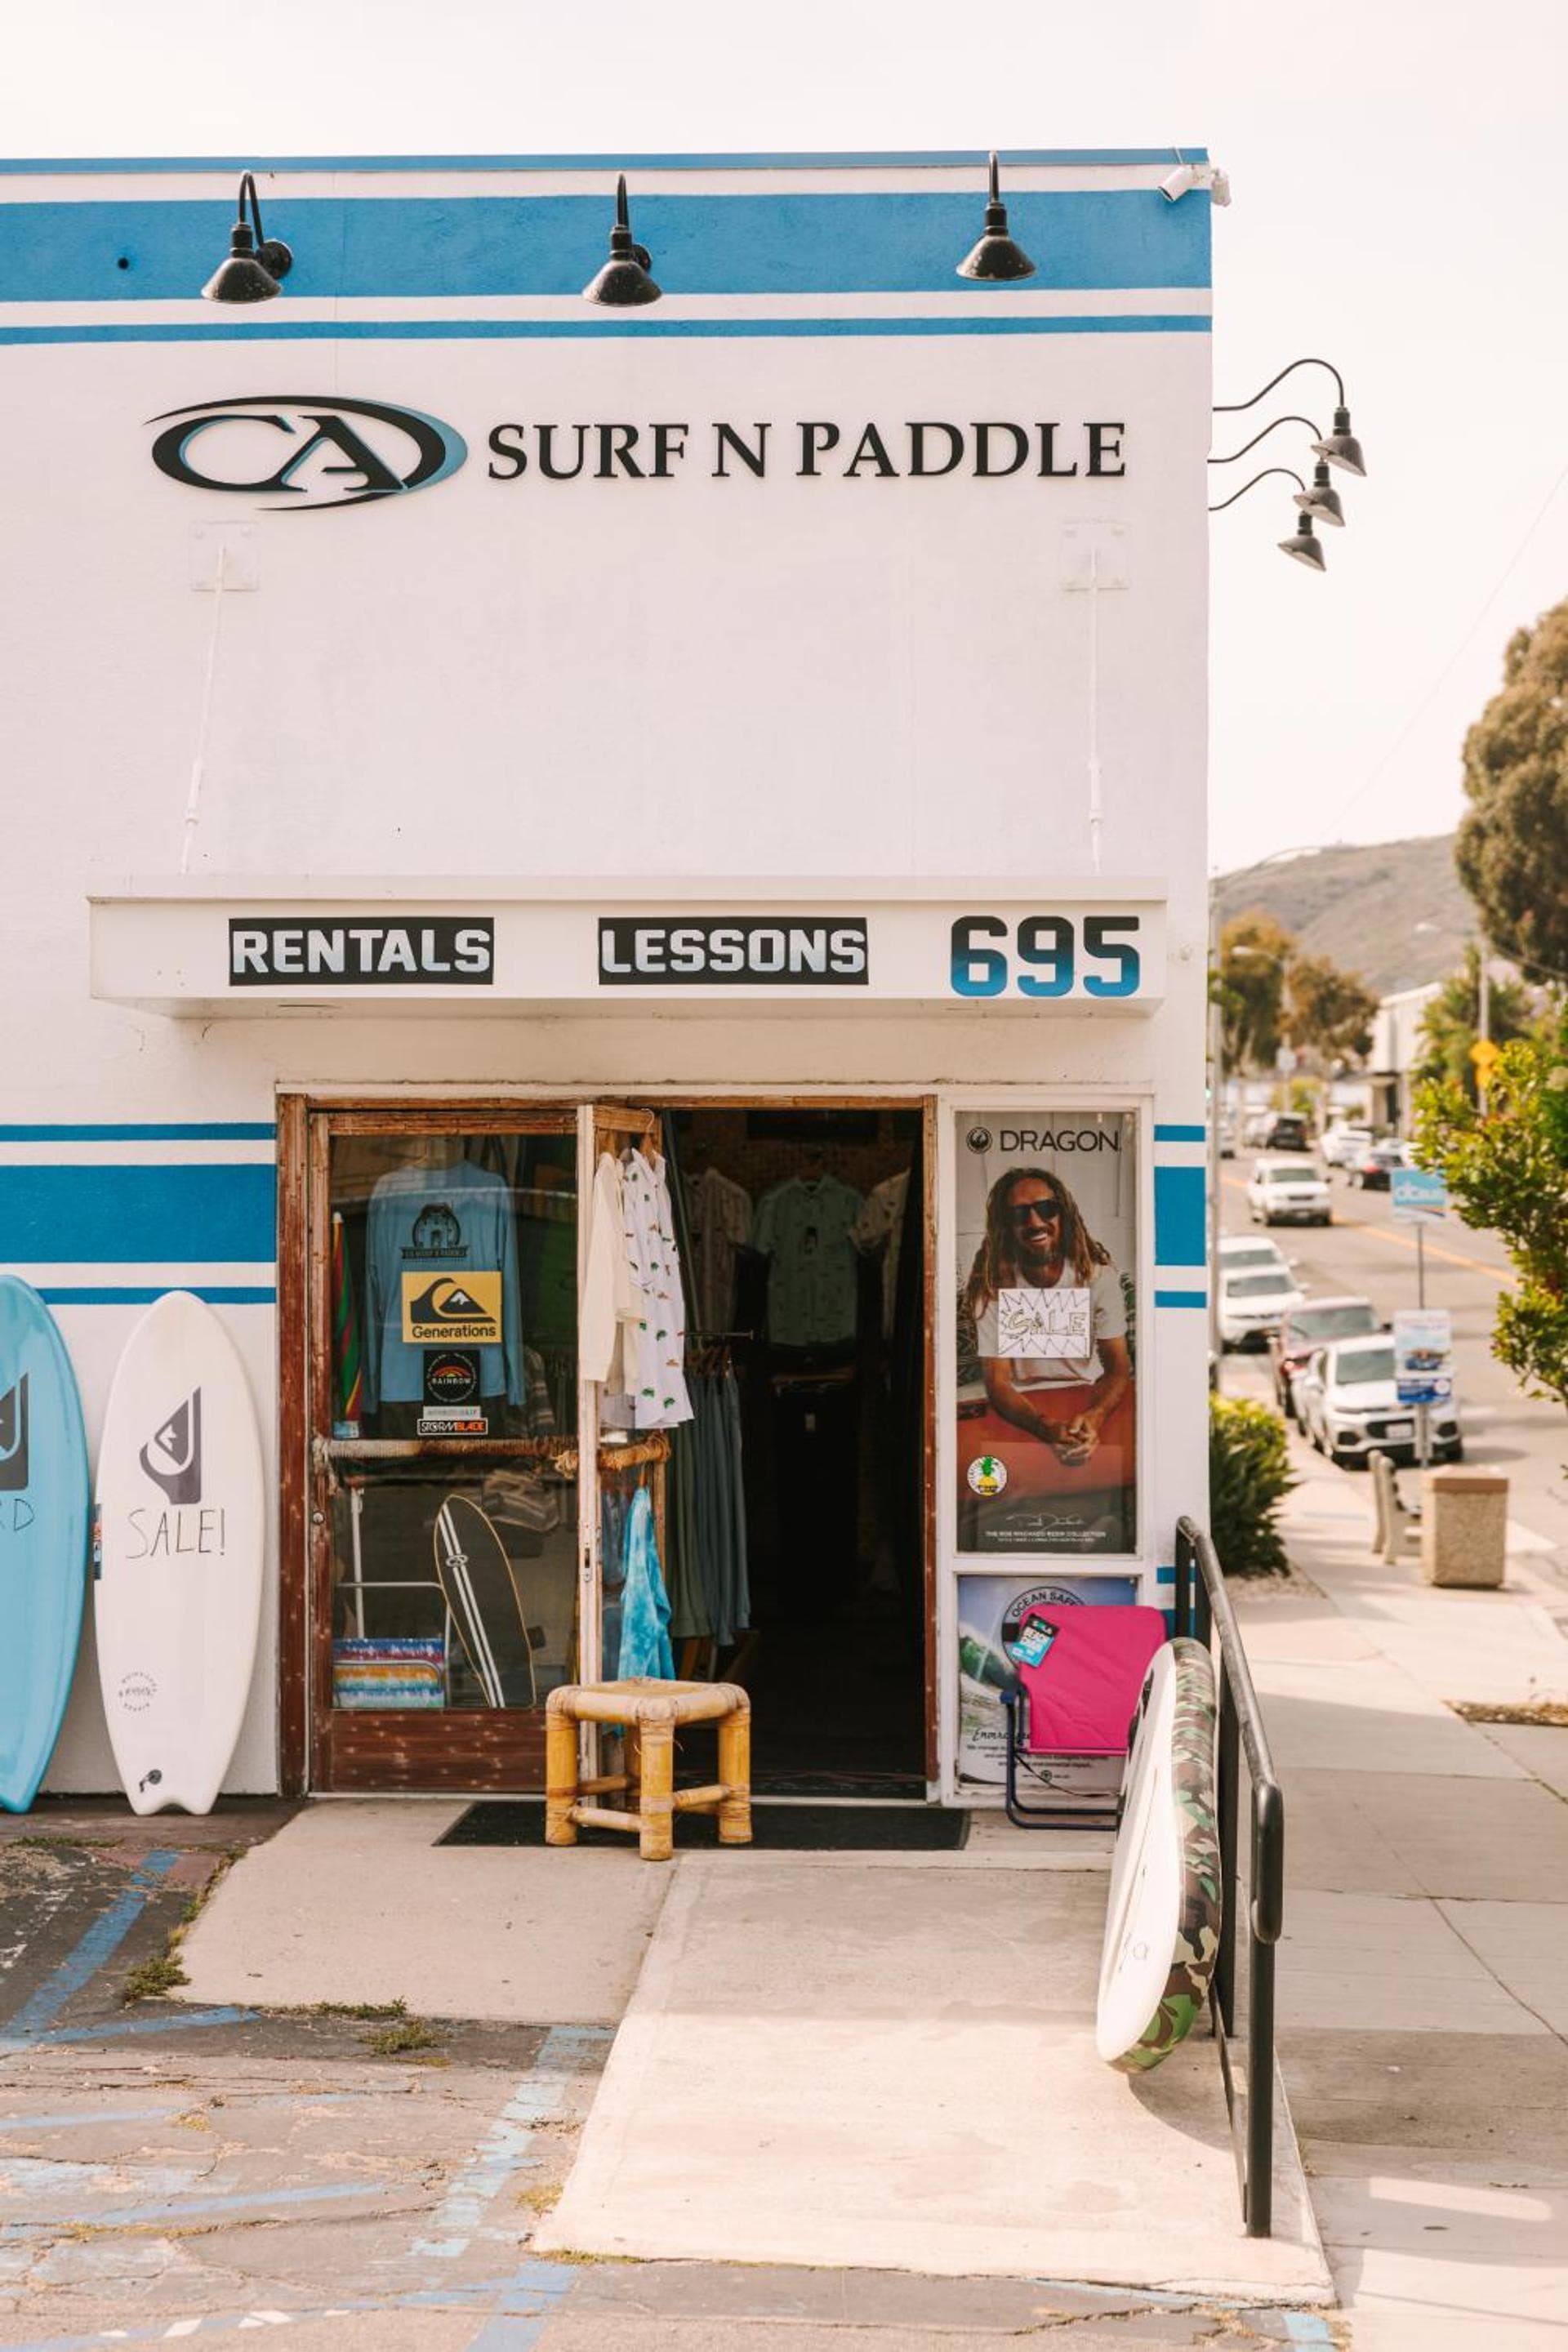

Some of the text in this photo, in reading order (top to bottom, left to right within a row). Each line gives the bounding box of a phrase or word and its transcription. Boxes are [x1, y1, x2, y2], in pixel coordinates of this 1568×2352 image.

[488, 421, 689, 480] SURF
[711, 422, 773, 478] N
[795, 421, 1127, 479] PADDLE
[231, 928, 491, 975] RENTALS
[601, 928, 867, 974] LESSONS
[950, 915, 1141, 998] 695
[1000, 1129, 1119, 1152] DRAGON
[412, 1325, 497, 1339] Generations
[1008, 1308, 1087, 1337] SALE
[431, 1377, 472, 1385] RAINBOW
[421, 1421, 484, 1432] STORMBLADE
[126, 1508, 226, 1560] SALE!
[1012, 1592, 1047, 1617] OCEAN
